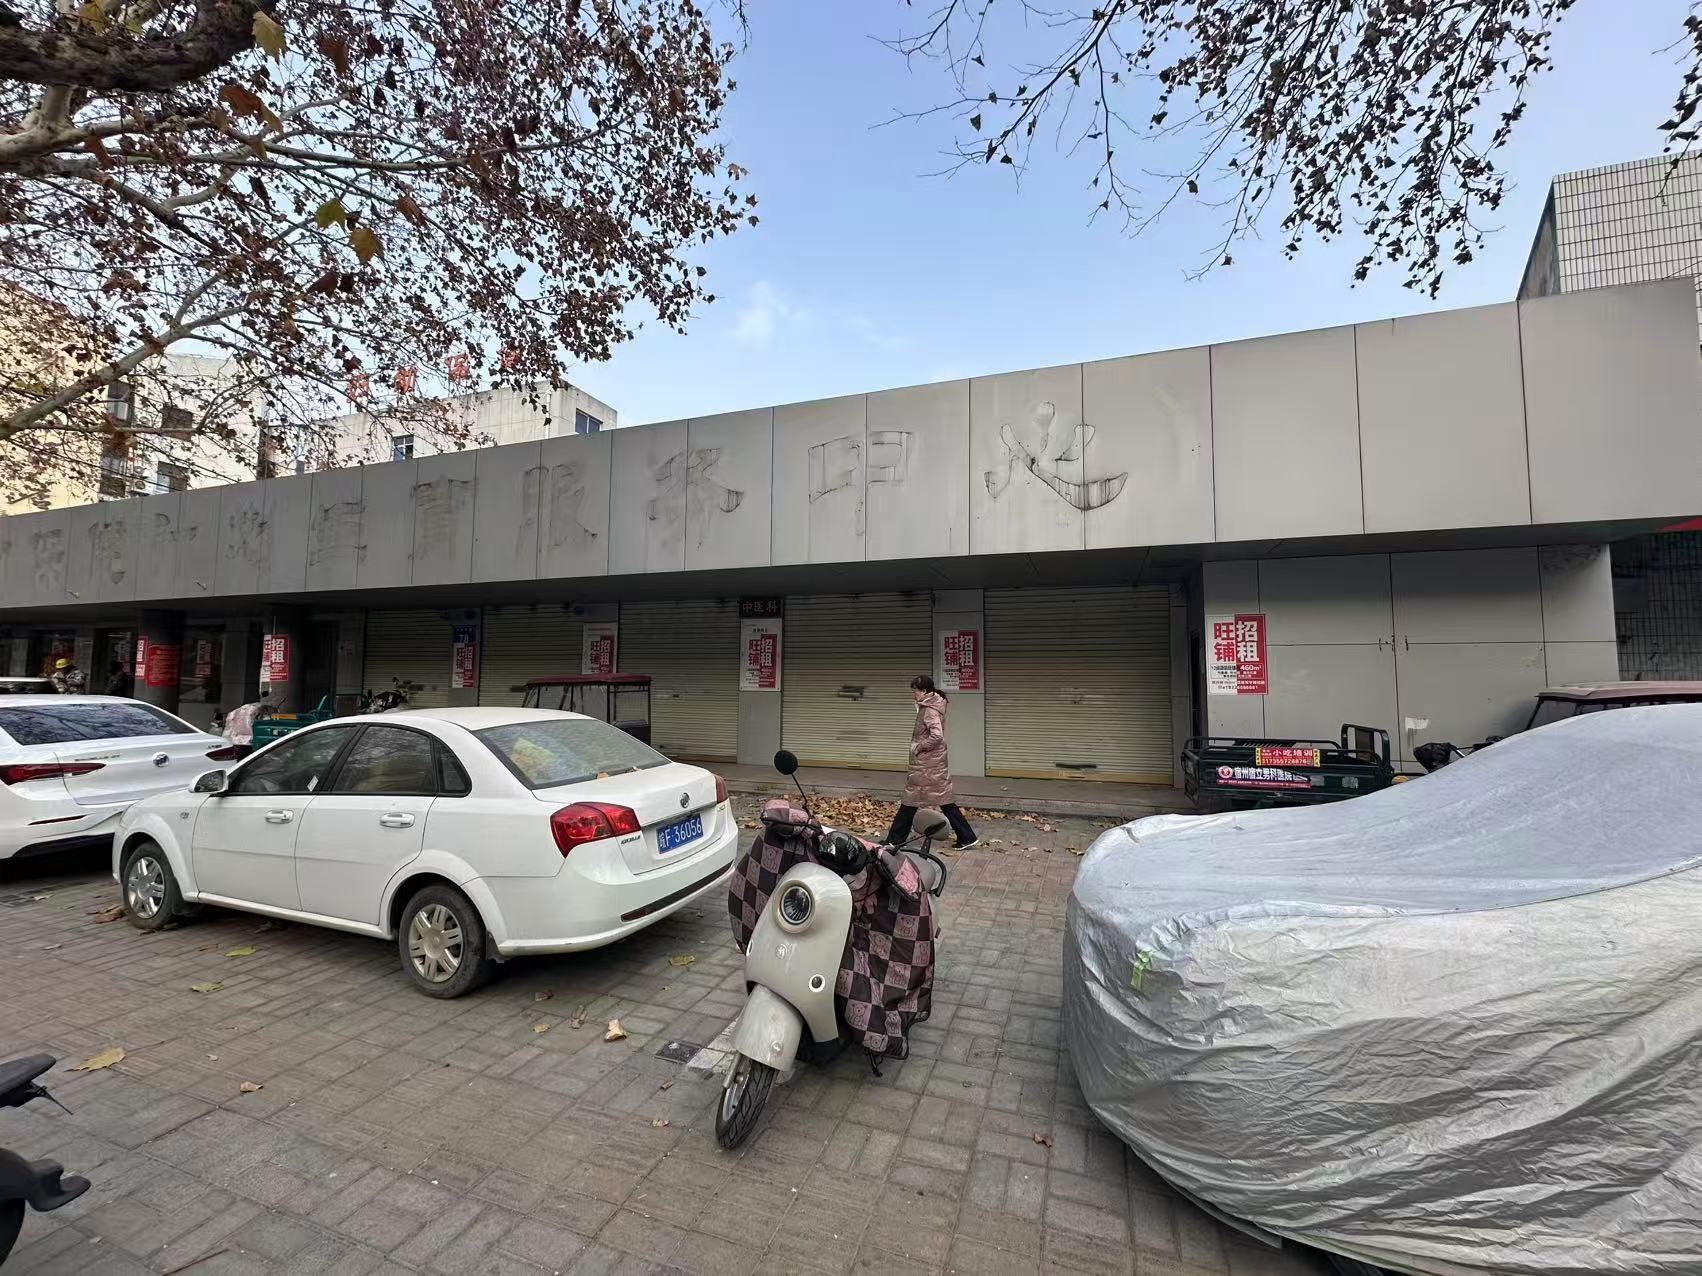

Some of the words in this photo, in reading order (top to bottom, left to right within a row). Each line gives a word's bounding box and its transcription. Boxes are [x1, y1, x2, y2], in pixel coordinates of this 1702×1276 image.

[743, 601, 778, 613] 中医科
[271, 638, 285, 663] 招租
[959, 635, 974, 666] 招租
[1213, 622, 1235, 662] 旺铺
[1236, 621, 1259, 662] 招租
[1273, 749, 1313, 757] 小吃培训
